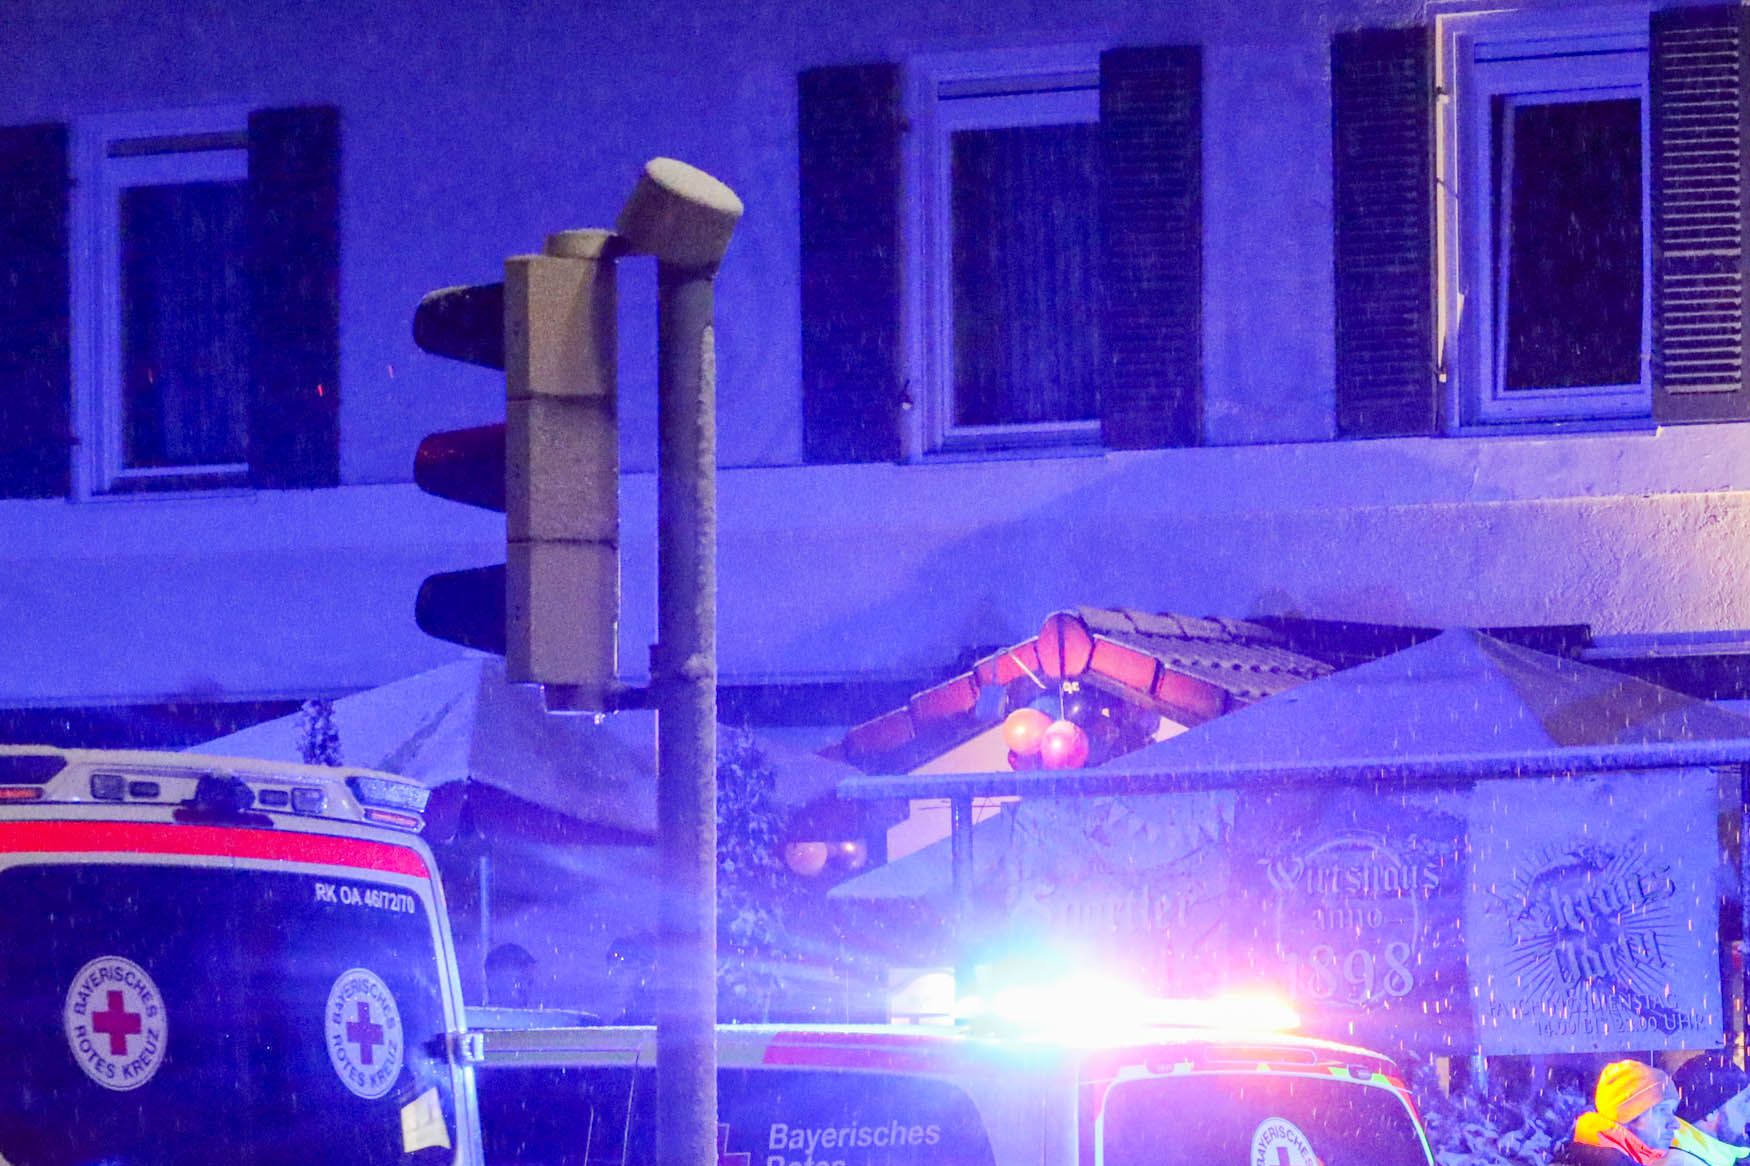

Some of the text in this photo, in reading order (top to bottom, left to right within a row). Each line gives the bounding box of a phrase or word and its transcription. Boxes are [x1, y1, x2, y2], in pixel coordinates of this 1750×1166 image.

[315, 883, 337, 903] RK
[341, 886, 362, 906] OA
[1256, 857, 1440, 897] Wirtshaus
[1312, 906, 1383, 929] anno
[1286, 941, 1415, 1001] 1898
[74, 966, 157, 1017] BAYERISCHES
[74, 1024, 159, 1080] ROTES KREUZ
[768, 1119, 941, 1154] Bayerisches
